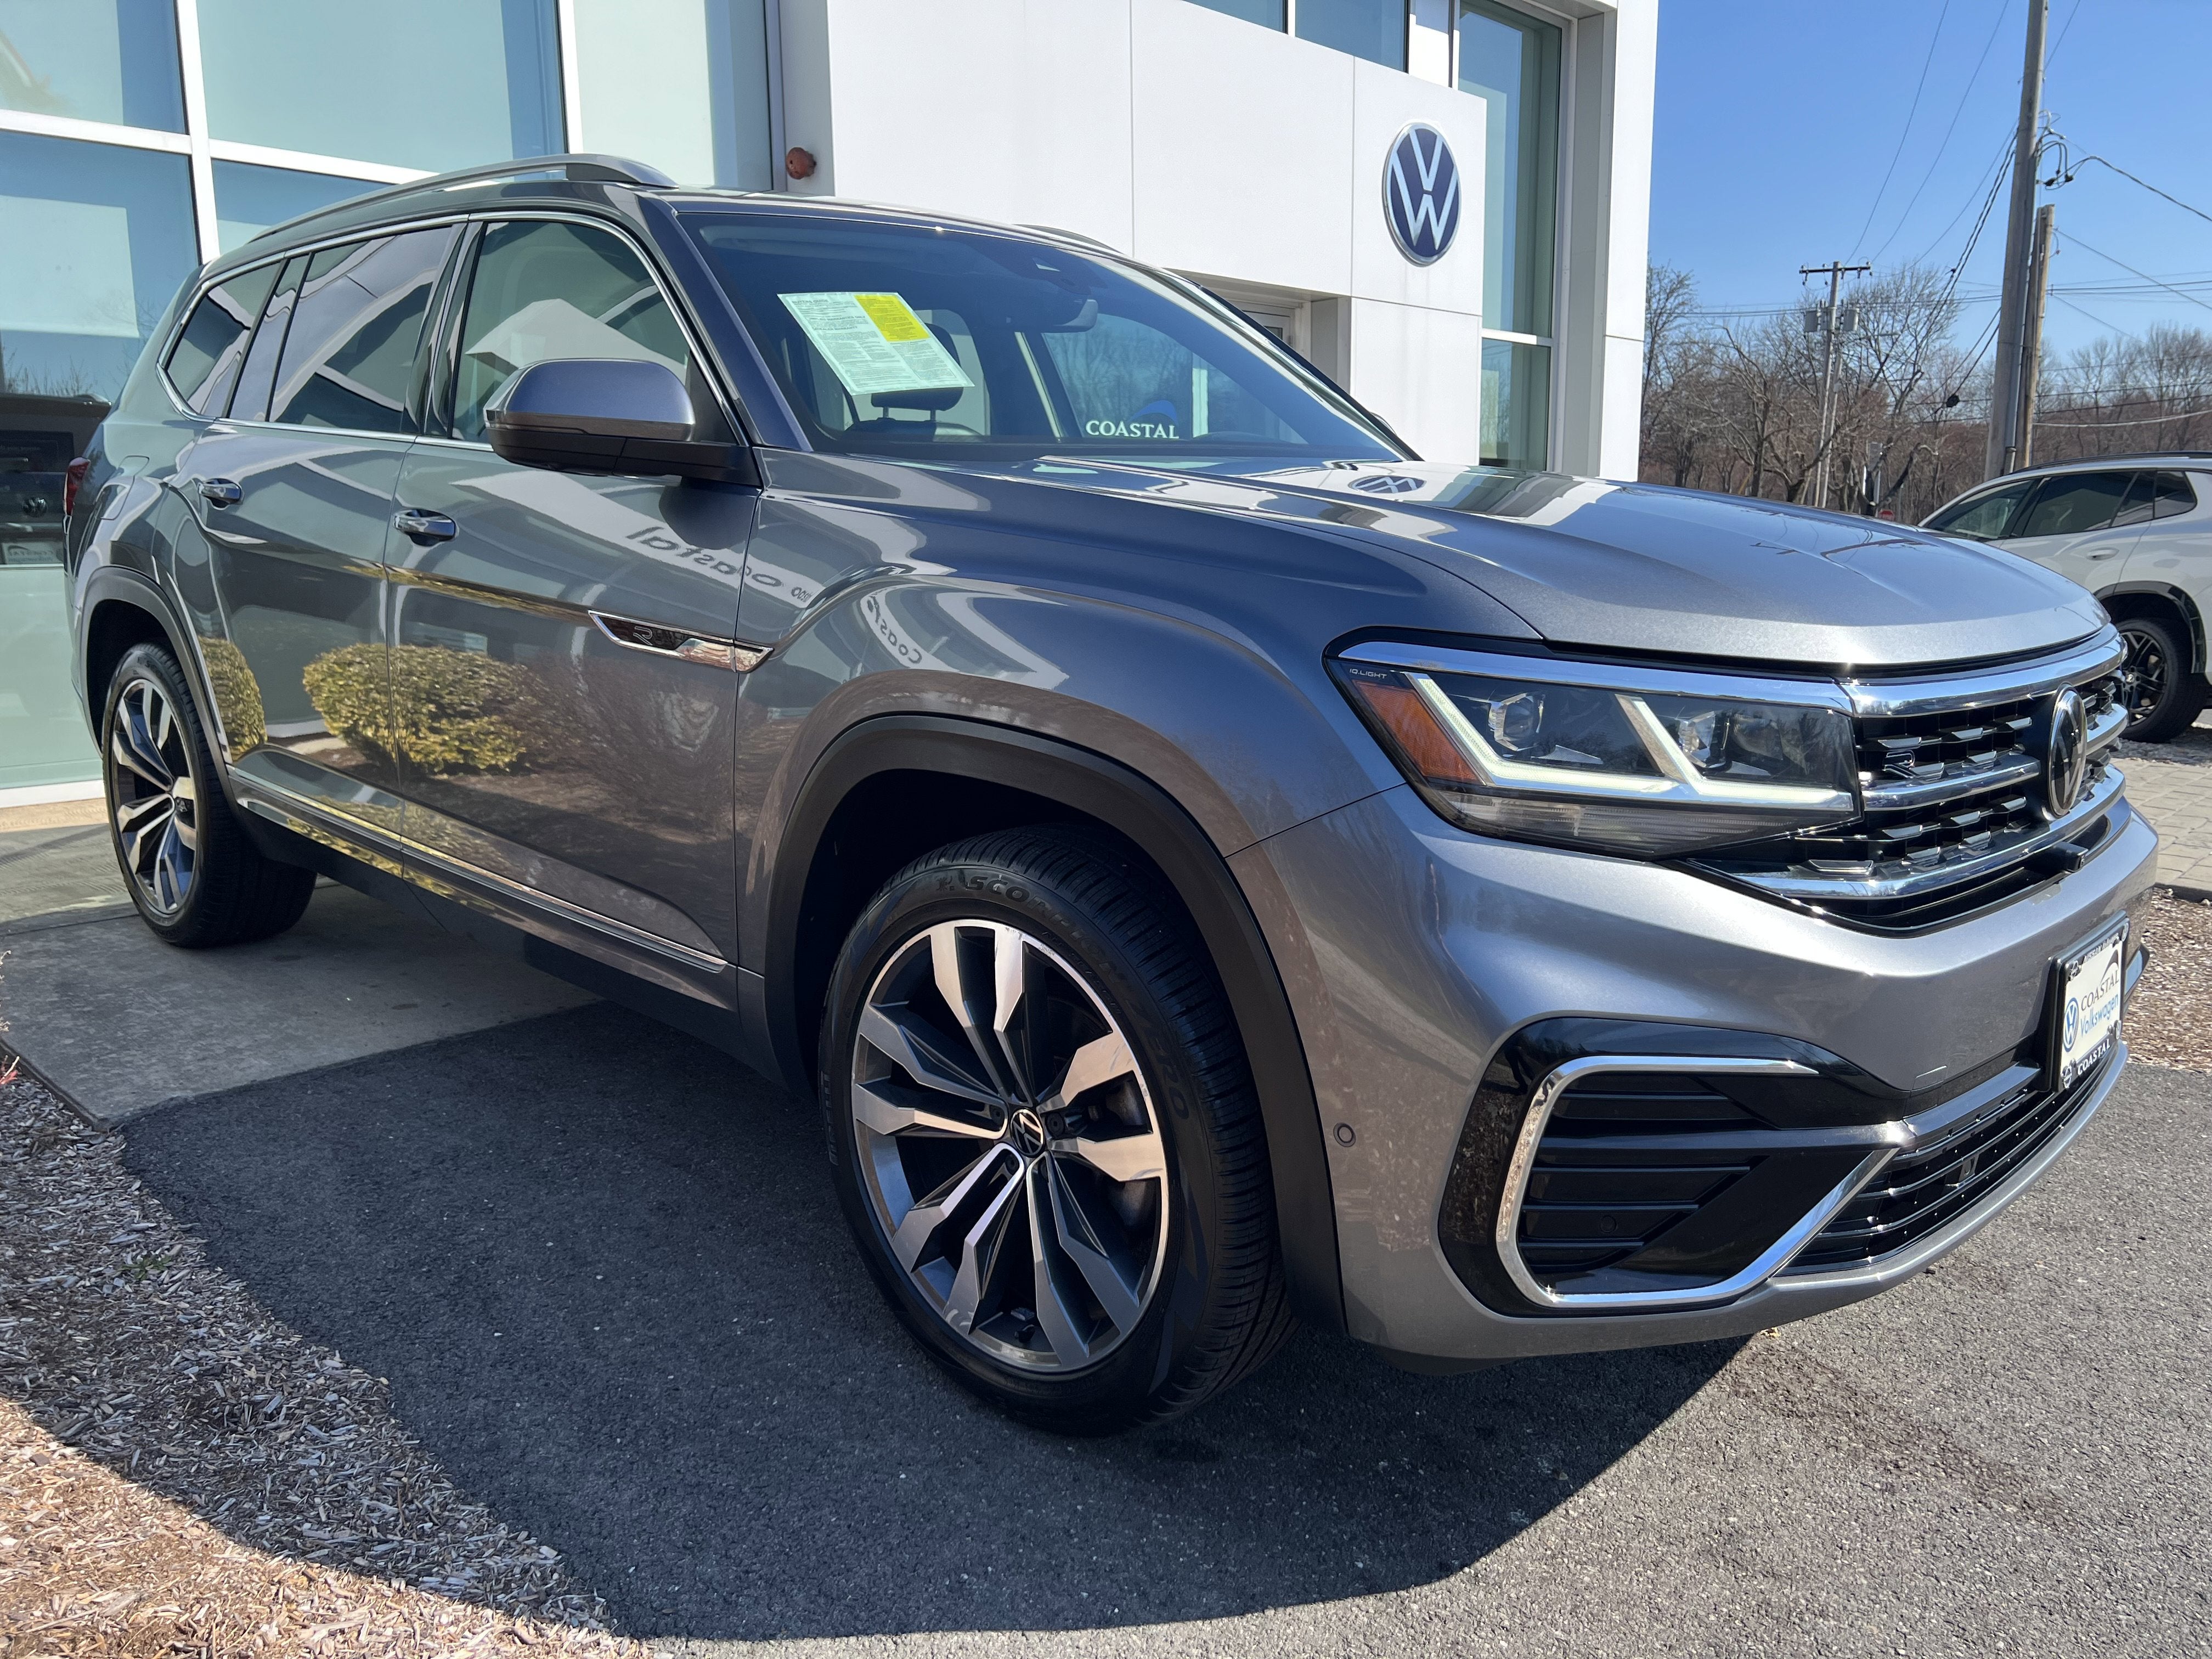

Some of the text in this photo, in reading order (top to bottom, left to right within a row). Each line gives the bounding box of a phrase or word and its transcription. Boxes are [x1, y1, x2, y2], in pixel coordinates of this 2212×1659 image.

[1386, 124, 1460, 258] VW
[1086, 420, 1180, 439] COASTAL
[1349, 668, 1387, 679] IQ.LIGHT
[2081, 969, 2119, 1012] COASTAL
[2080, 994, 2119, 1037] Volkswagen
[2077, 1038, 2111, 1075] COASTAL
